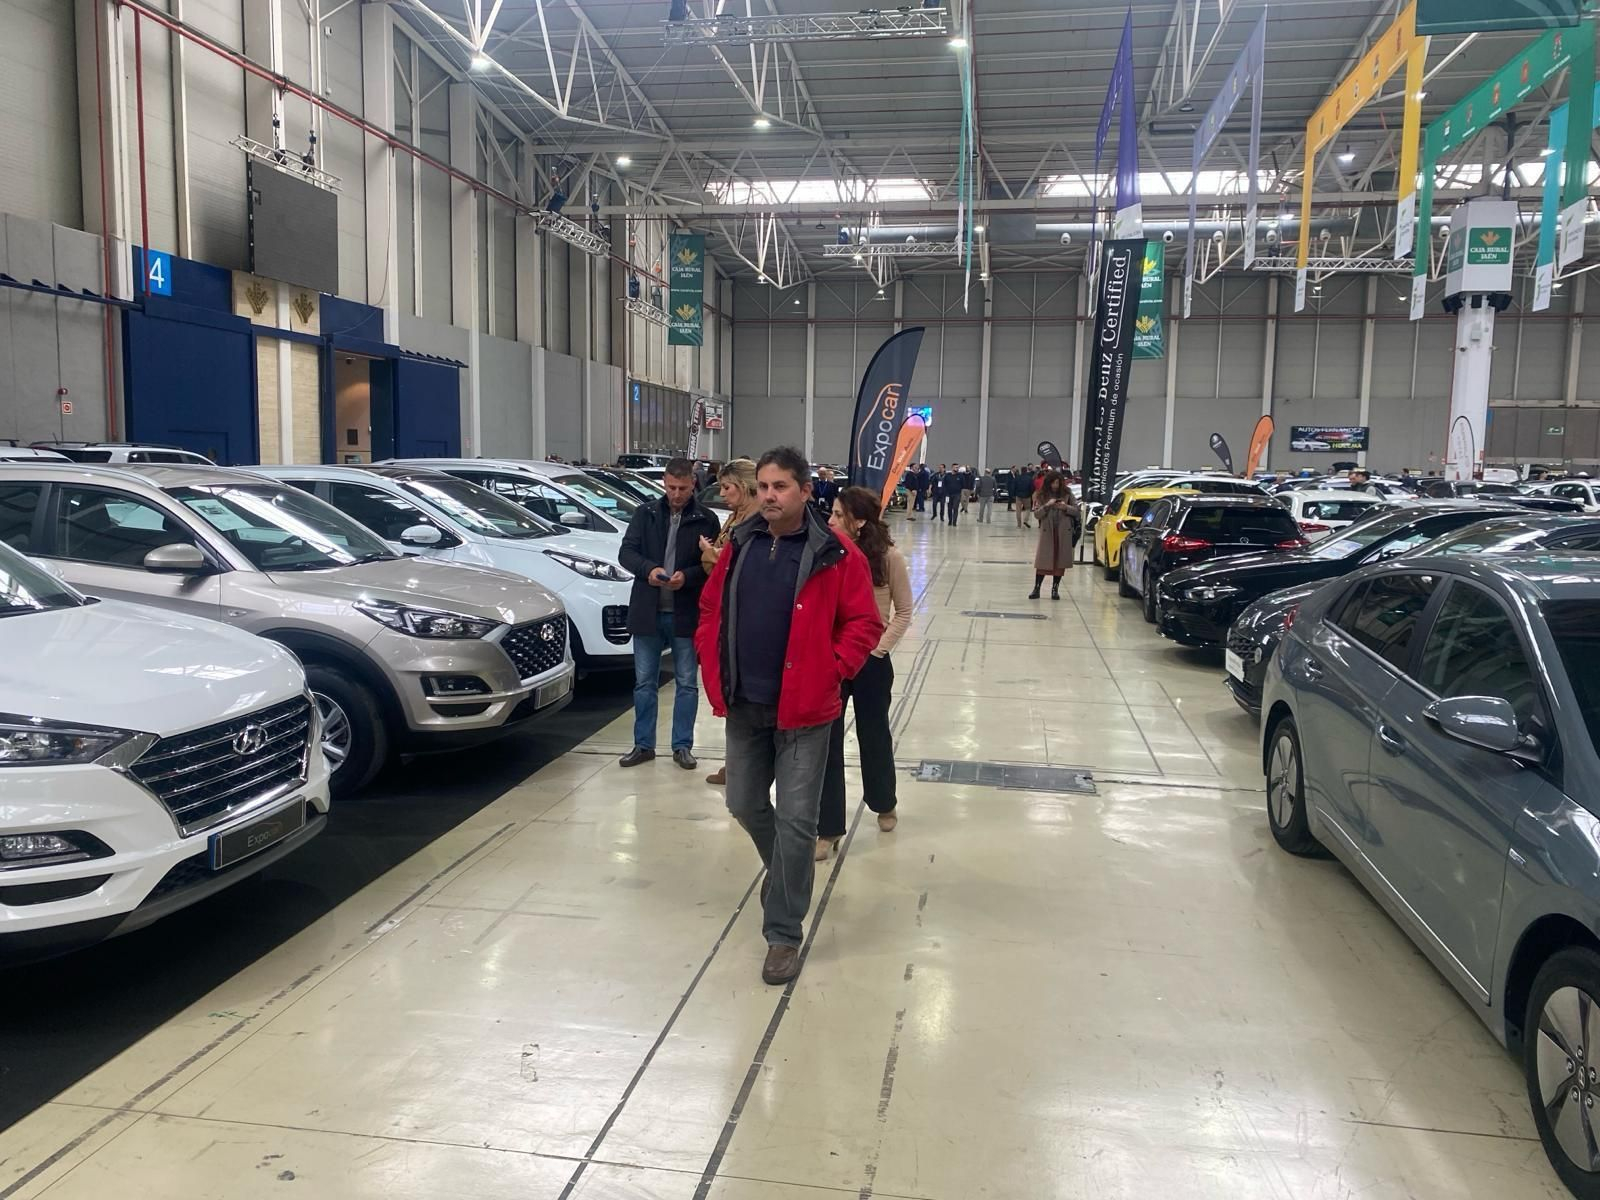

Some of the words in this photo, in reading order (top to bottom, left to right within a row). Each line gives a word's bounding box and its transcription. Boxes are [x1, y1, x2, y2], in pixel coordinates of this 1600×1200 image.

[149, 257, 165, 288] 4
[1103, 256, 1126, 342] Certified
[1113, 353, 1124, 391] ocasión
[634, 386, 640, 401] 2
[1111, 393, 1119, 406] de
[867, 386, 900, 470] Expocar
[1104, 408, 1116, 450] Premium
[1100, 452, 1111, 496] vehículos
